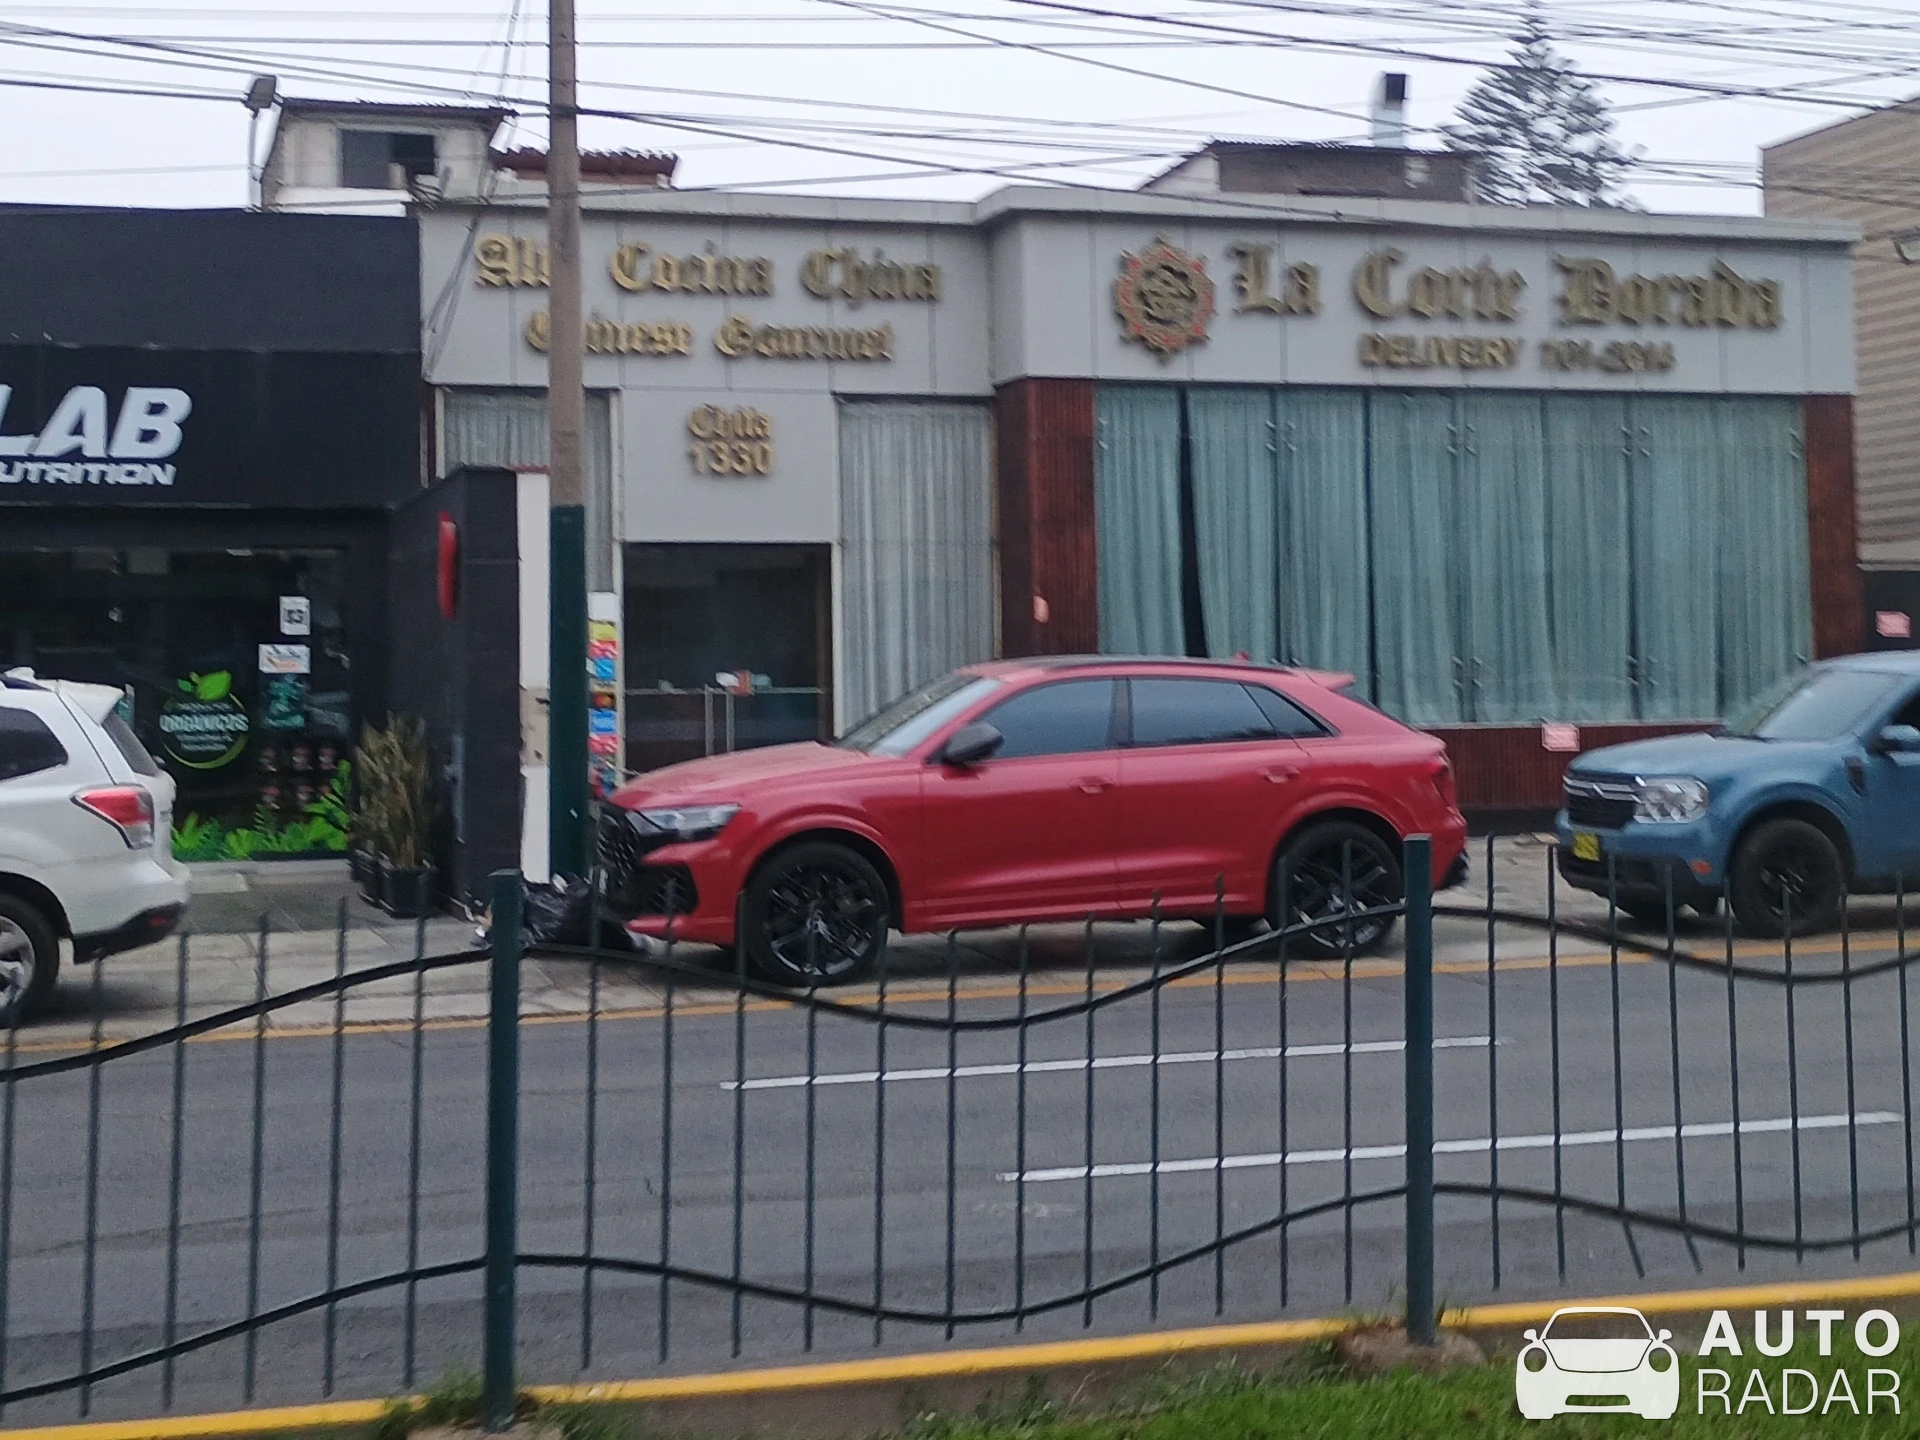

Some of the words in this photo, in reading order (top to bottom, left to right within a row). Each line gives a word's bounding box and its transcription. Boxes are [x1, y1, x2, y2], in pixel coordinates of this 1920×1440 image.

[609, 239, 775, 296] Cocina
[801, 245, 943, 310] China
[1231, 240, 1321, 316] La
[1353, 246, 1527, 321] Corte
[1553, 256, 1785, 328] Dorada
[688, 441, 775, 476] 1330
